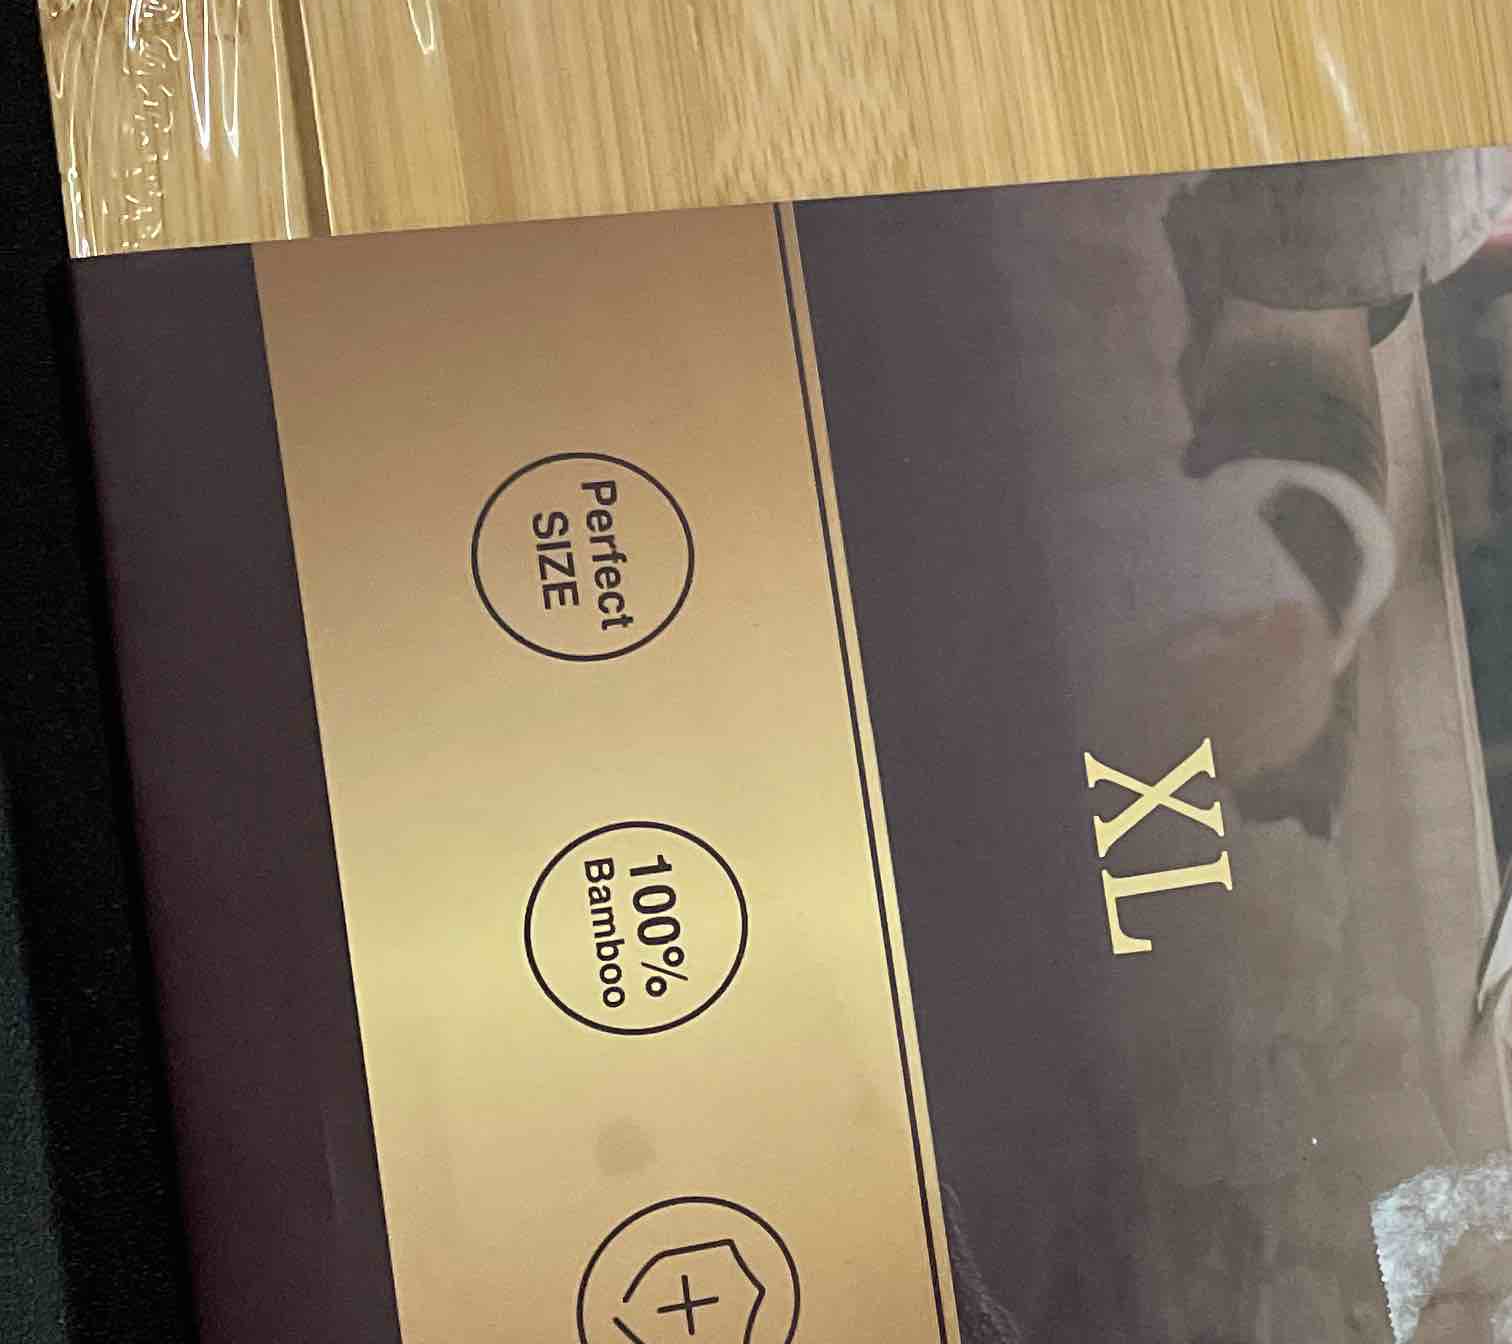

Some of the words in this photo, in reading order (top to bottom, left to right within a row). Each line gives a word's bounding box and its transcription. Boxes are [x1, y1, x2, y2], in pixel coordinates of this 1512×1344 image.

[531, 510, 581, 611] SIZE
[579, 478, 635, 632] Perfect
[1083, 737, 1233, 955] XL
[582, 856, 627, 1009] Bamboo
[627, 852, 689, 1000] 100%
